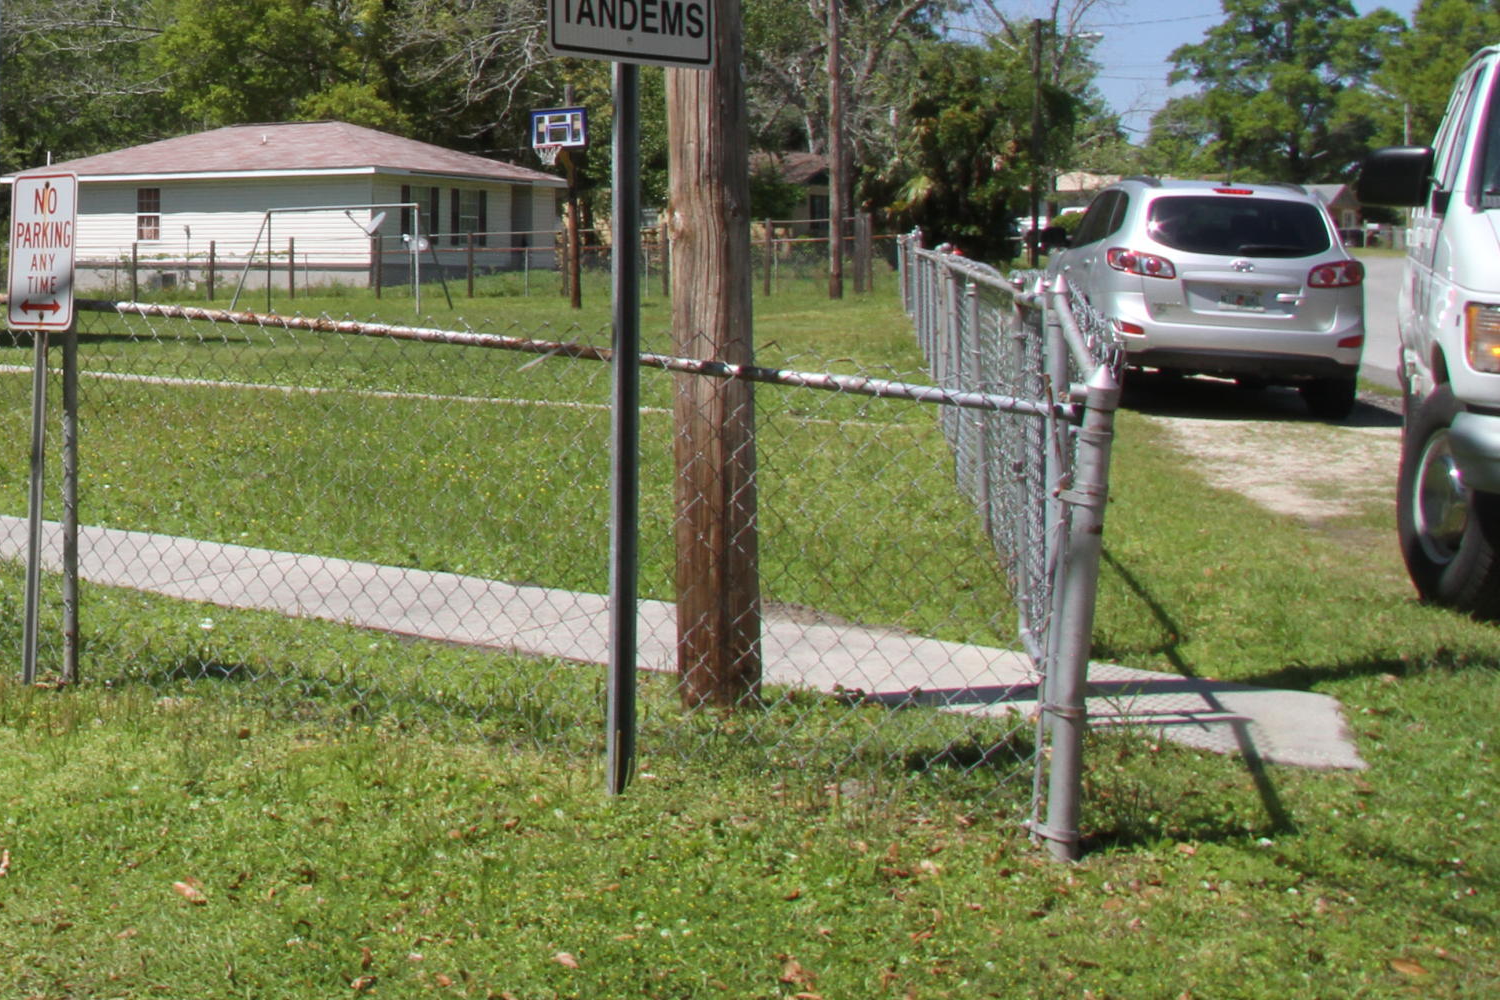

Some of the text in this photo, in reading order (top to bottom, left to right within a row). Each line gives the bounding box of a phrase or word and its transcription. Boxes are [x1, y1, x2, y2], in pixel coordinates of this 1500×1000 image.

[34, 187, 57, 215] NO
[16, 221, 71, 249] PARKING
[30, 253, 56, 272] ANY
[28, 276, 57, 295] TIME
